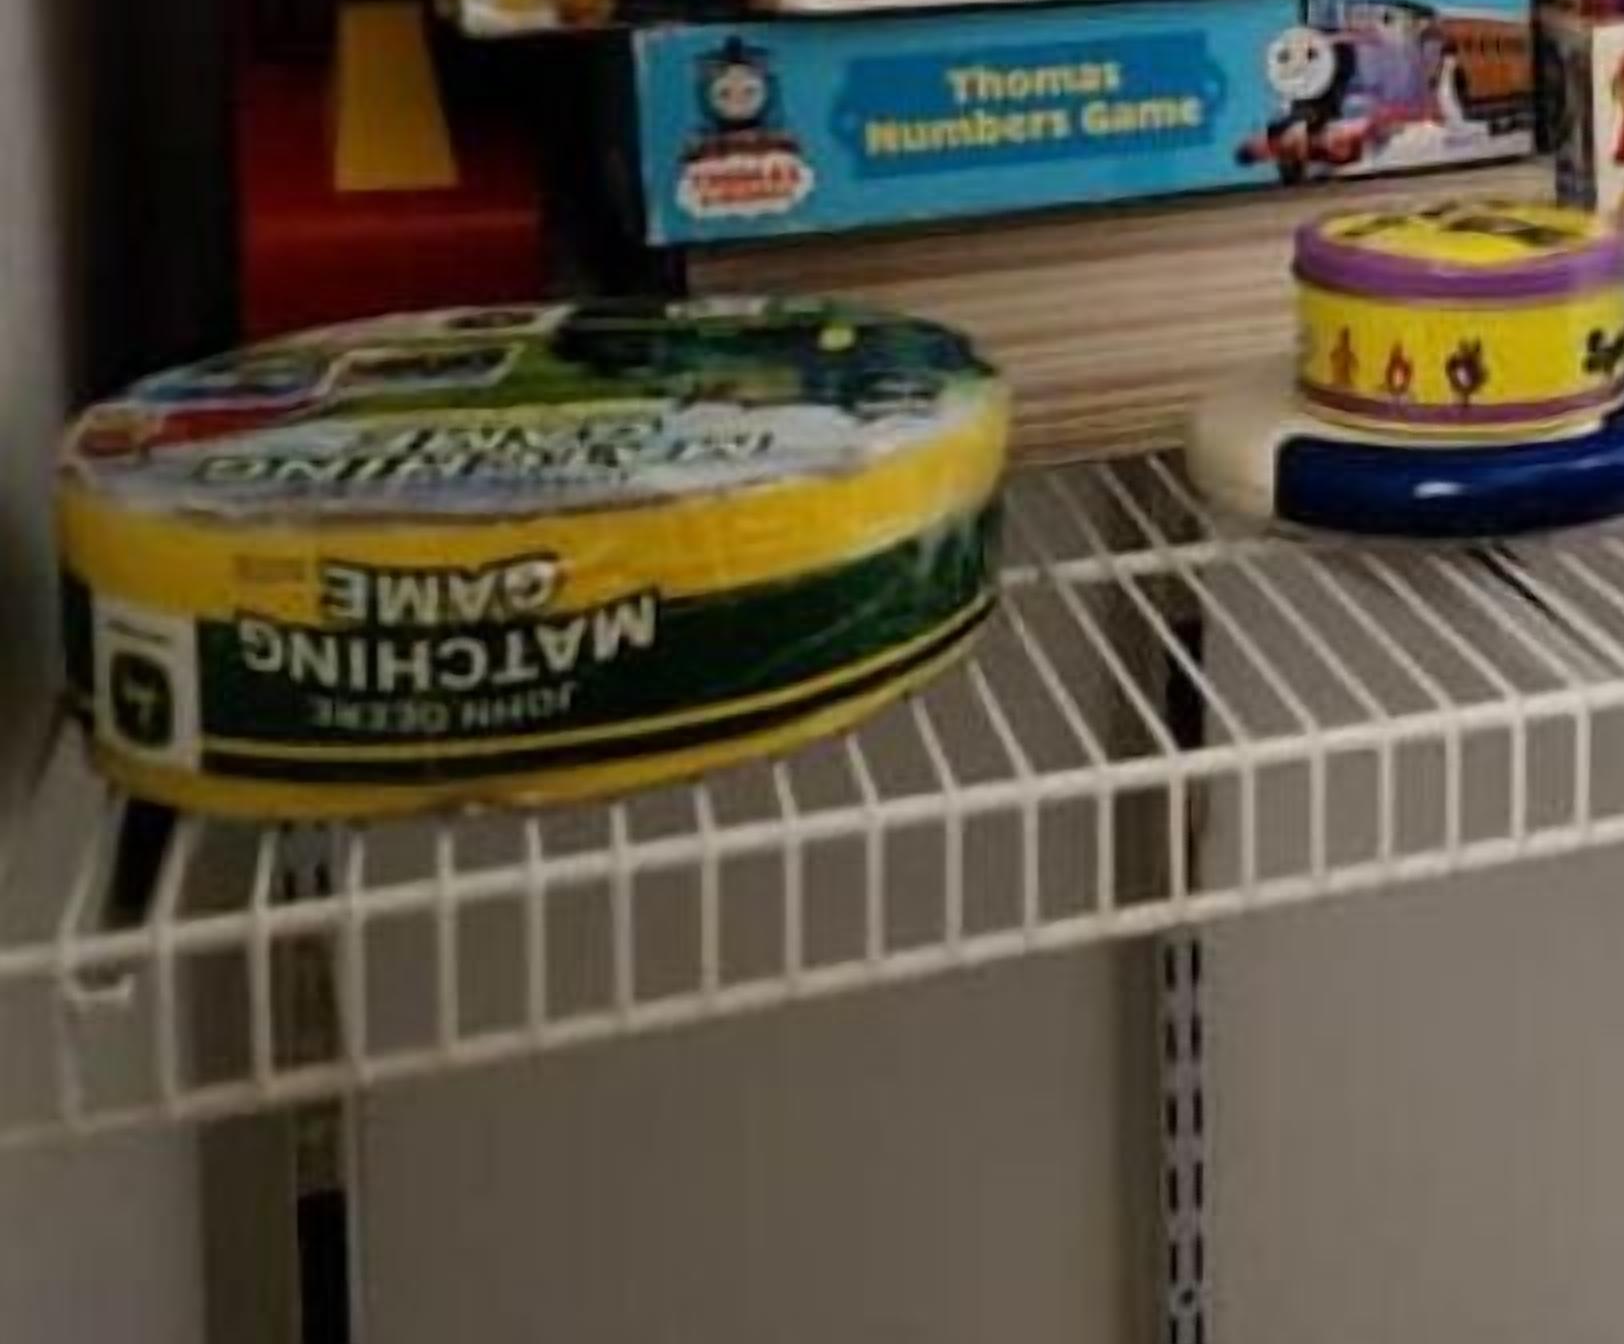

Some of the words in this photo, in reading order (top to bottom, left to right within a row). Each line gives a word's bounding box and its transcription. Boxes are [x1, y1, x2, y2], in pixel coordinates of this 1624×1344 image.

[944, 62, 1120, 104] Thomas
[865, 111, 1071, 155] Numbers
[1080, 95, 1203, 135] Game
[322, 559, 562, 627] GAME
[238, 596, 658, 692] MATCHING
